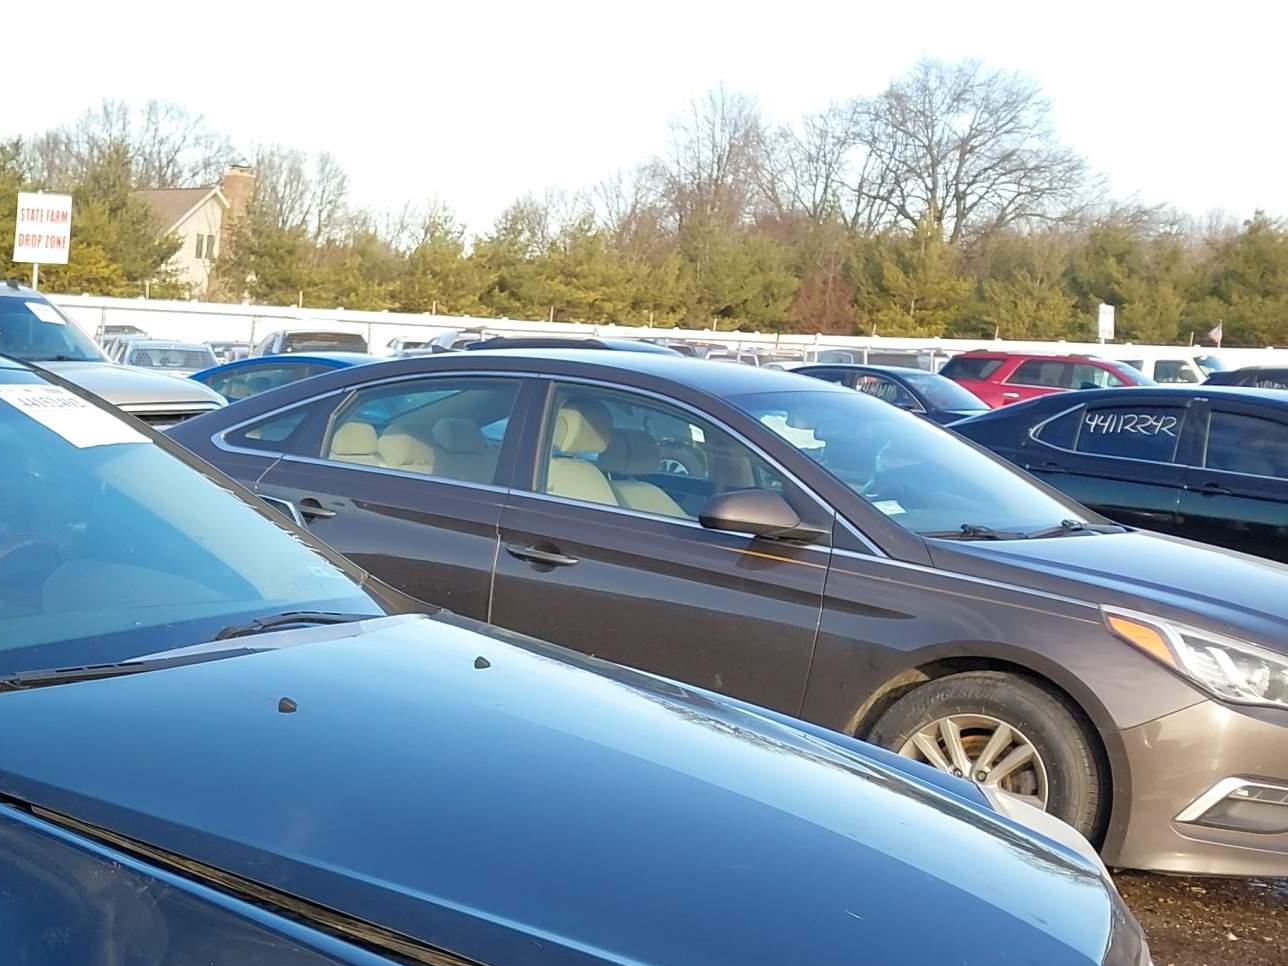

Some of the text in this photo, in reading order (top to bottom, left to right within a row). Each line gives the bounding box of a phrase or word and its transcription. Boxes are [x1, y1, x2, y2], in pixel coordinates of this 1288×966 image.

[20, 207, 68, 225] STATE FARM
[18, 233, 67, 250] DROP ZONE
[1085, 413, 1177, 438] 44112242
